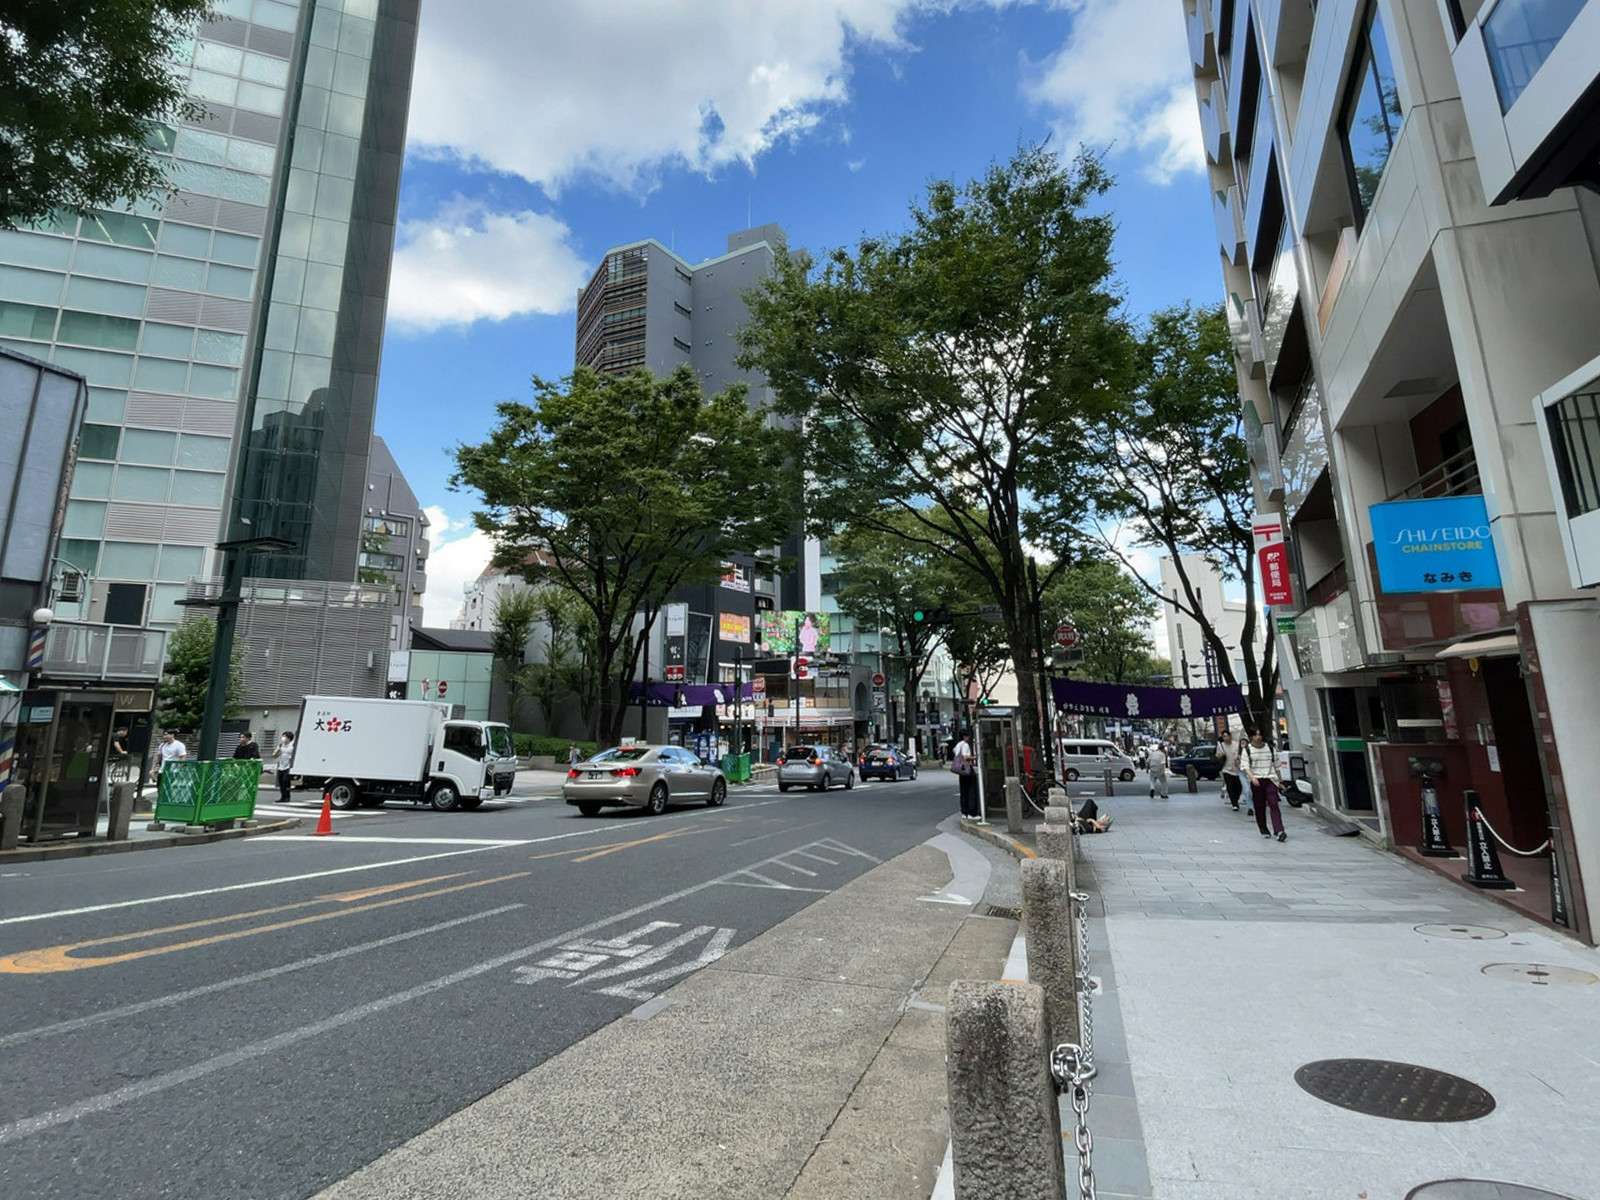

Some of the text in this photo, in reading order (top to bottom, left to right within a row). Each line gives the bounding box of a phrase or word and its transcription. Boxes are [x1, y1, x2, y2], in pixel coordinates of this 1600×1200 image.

[1389, 525, 1491, 545] SHISEIDO
[1402, 541, 1483, 554] CHAINSTORE
[1269, 562, 1282, 587] 郵便局
[1423, 571, 1473, 584] なみき
[1479, 841, 1493, 870] 立入禁止
